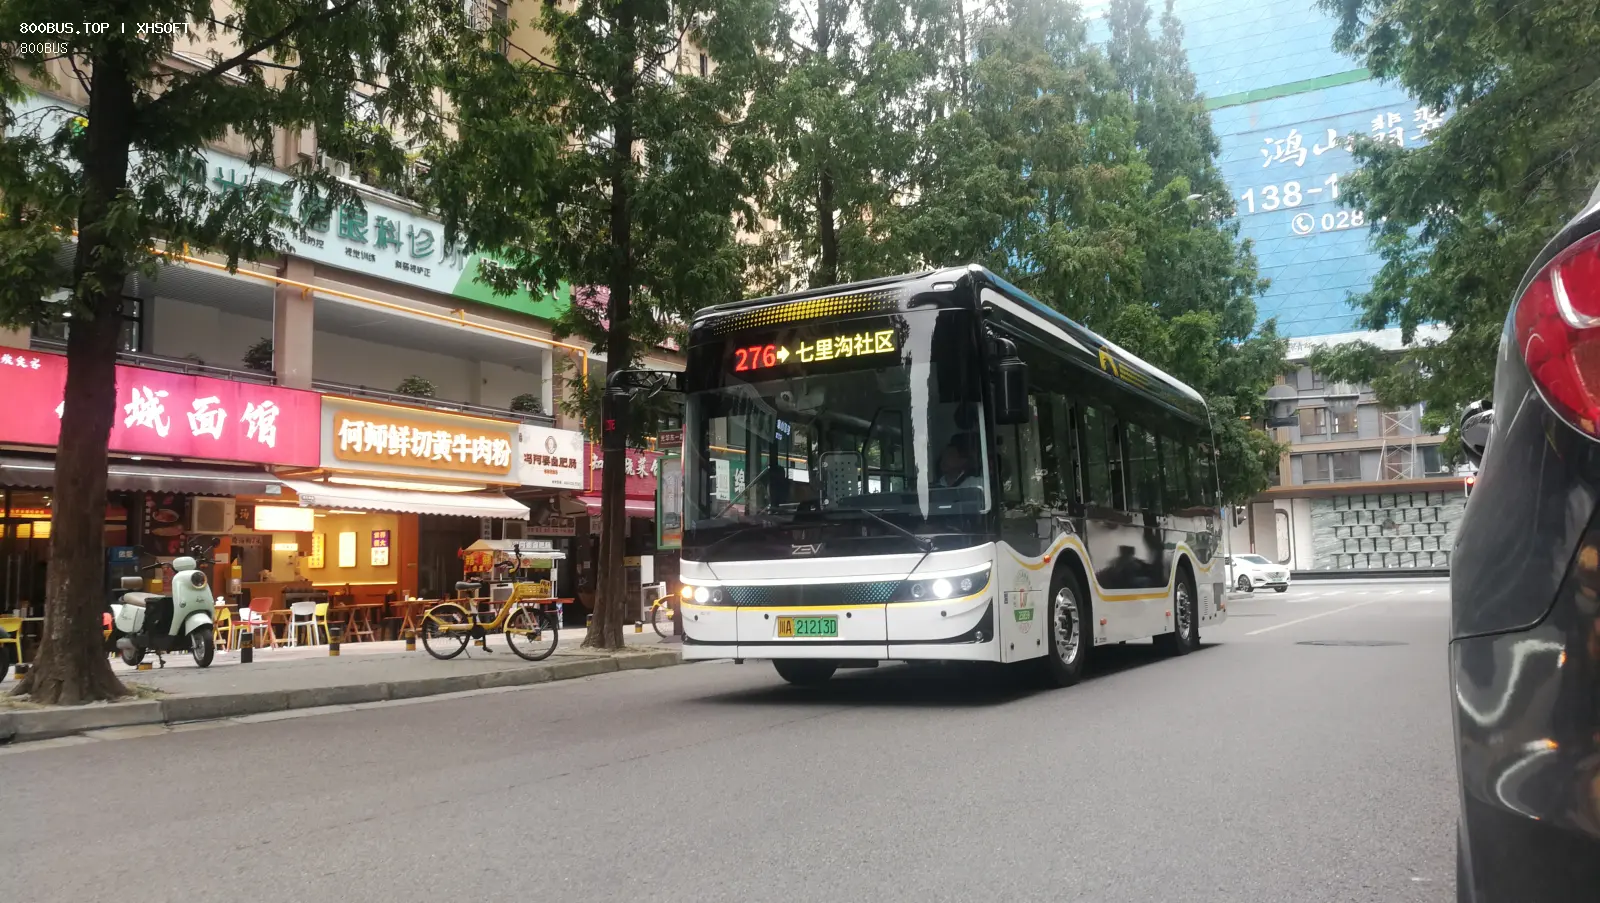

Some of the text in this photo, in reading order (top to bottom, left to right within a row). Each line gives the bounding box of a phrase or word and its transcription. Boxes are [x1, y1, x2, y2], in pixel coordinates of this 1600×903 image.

[735, 330, 895, 372] 276 七里沟社区
[55, 386, 281, 448] 城面馆
[338, 418, 512, 467] 何师鲜切黄牛肉粉
[523, 453, 577, 469] 冯阿婆卤肥肠
[791, 543, 822, 555] ZEV
